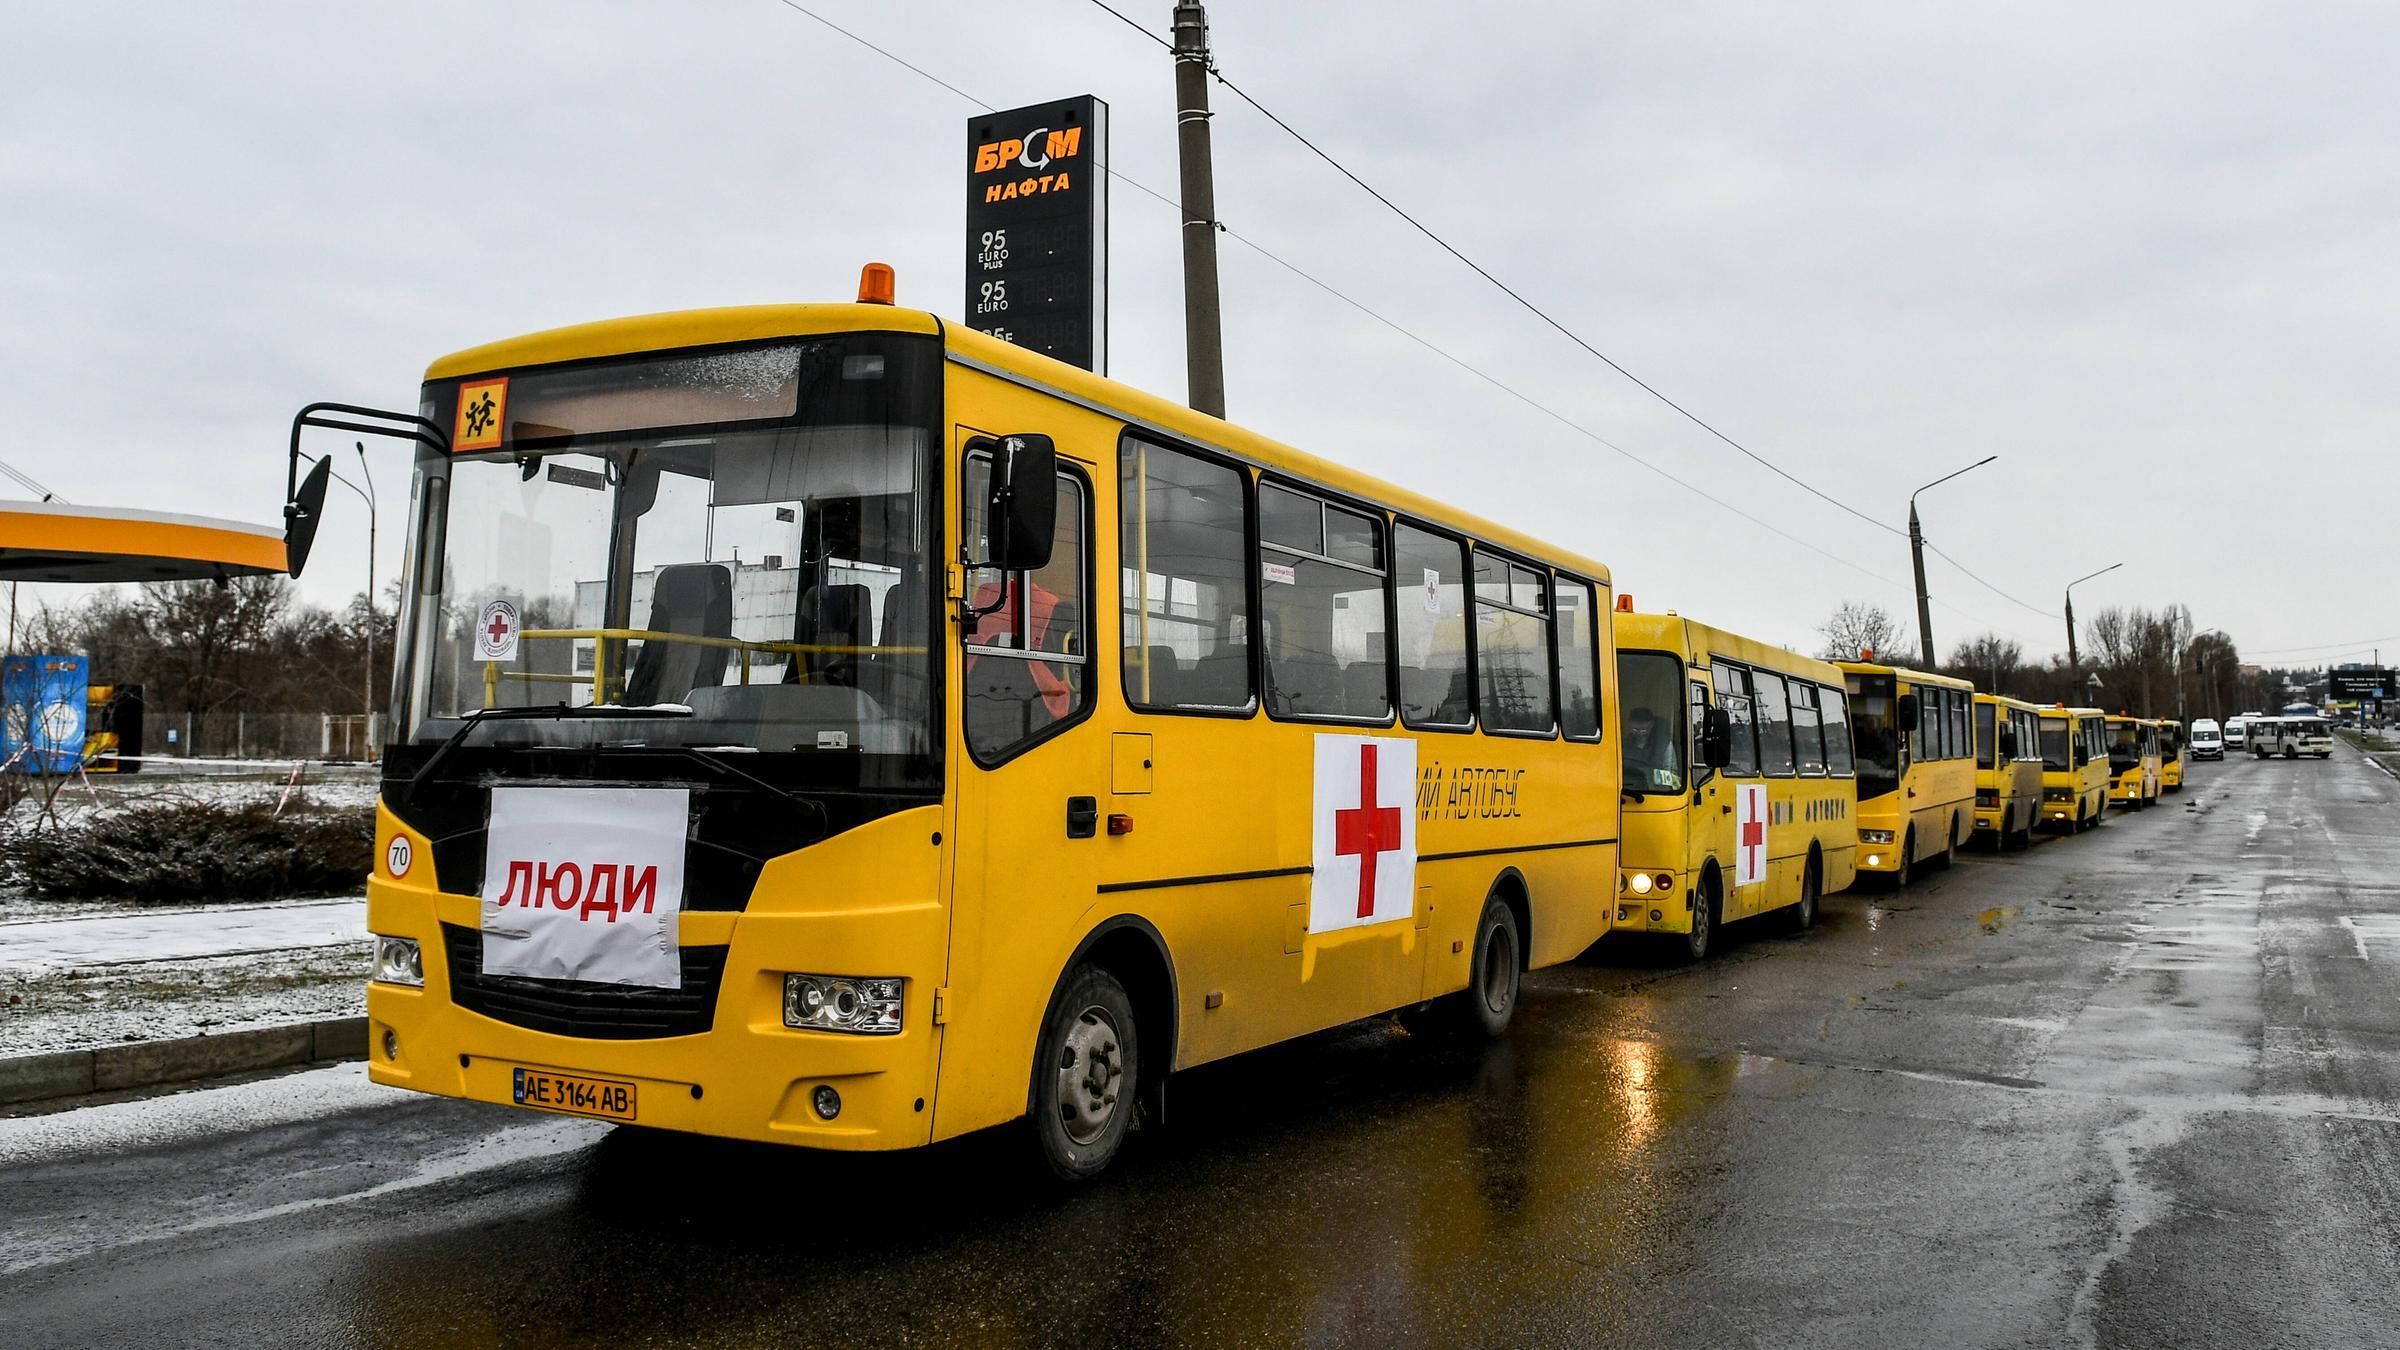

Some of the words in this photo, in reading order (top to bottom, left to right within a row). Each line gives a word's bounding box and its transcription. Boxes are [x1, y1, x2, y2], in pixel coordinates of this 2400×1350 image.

[975, 127, 1081, 173] БРСМ
[986, 173, 1069, 203] НАФТА
[982, 229, 1006, 252] 95
[978, 249, 1009, 263] EURO
[983, 260, 1003, 270] PLUS
[981, 280, 1006, 303] 95
[977, 300, 1009, 314] EURO
[1416, 761, 1442, 821] ИЙ
[1445, 767, 1525, 820] АВТОБУС
[392, 846, 408, 866] 70
[497, 861, 658, 923] ЛЮДИ
[525, 1076, 550, 1102] AE
[555, 1080, 596, 1109] 3164
[601, 1086, 628, 1113] AB
